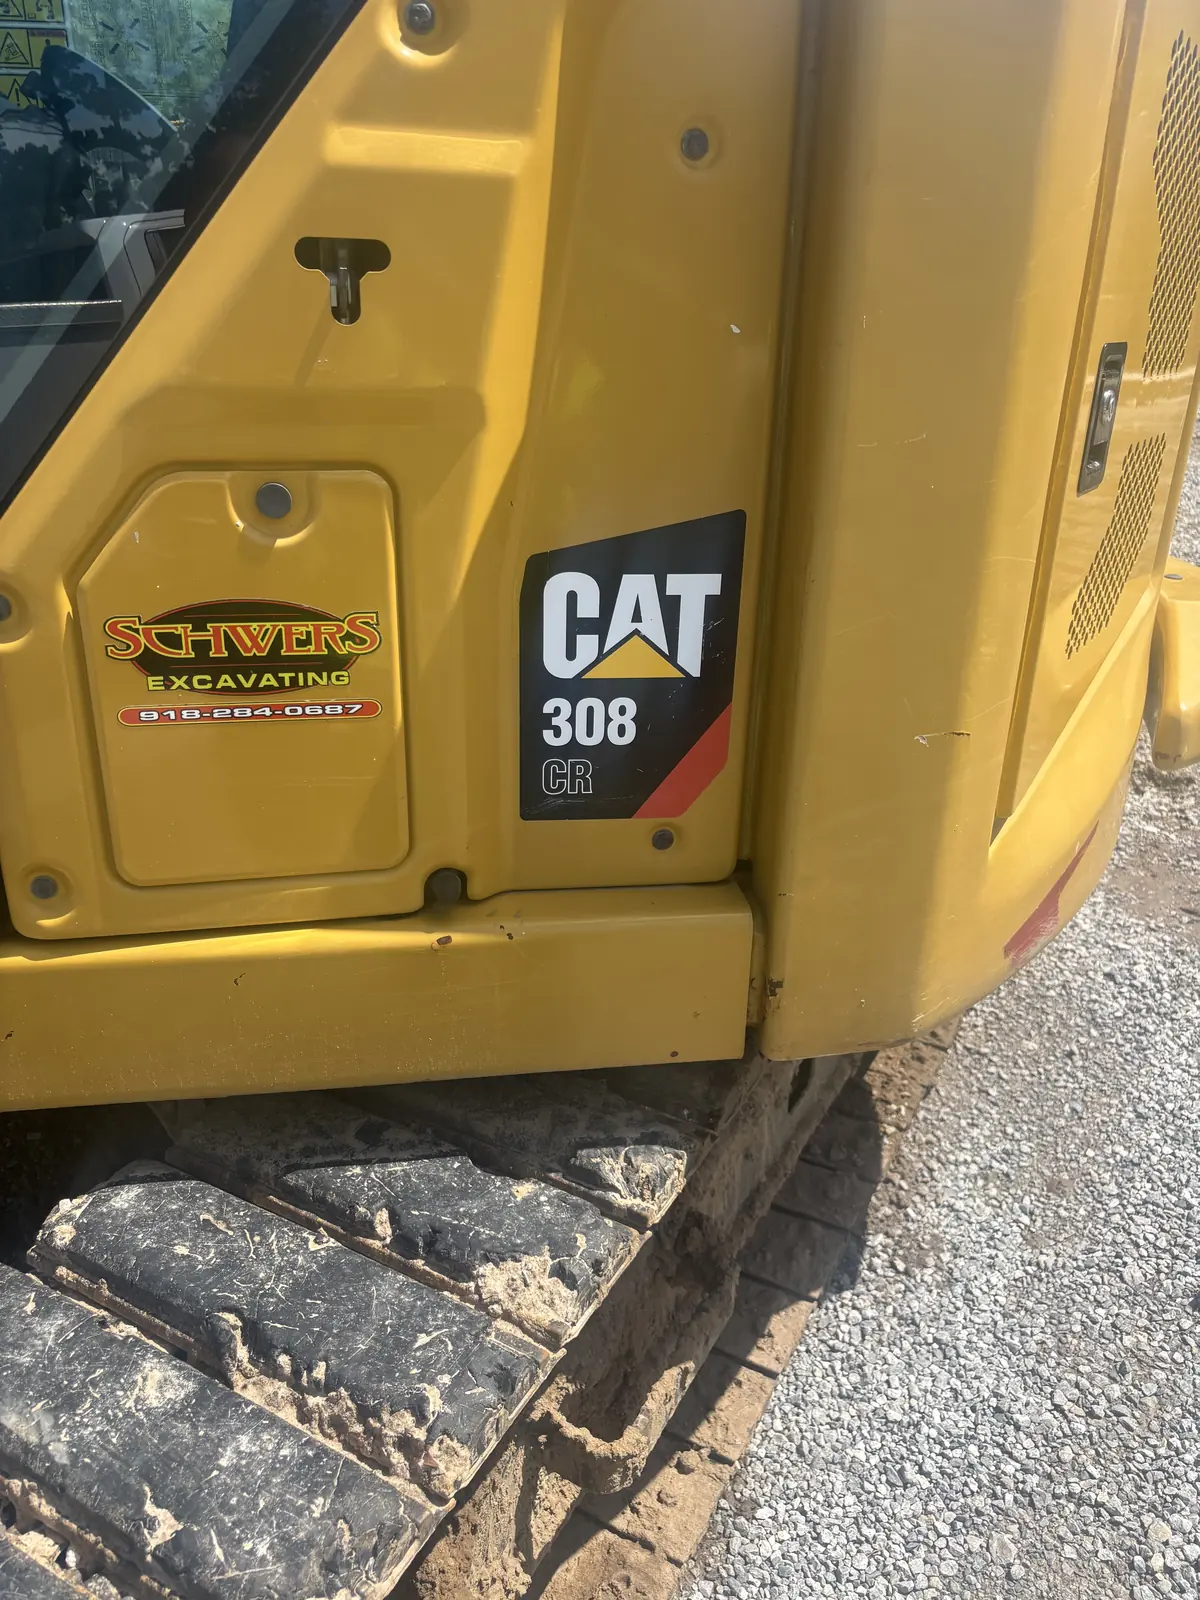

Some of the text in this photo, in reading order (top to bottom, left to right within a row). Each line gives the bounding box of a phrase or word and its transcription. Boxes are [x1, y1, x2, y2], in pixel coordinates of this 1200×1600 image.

[104, 612, 381, 659] SCHWERS
[543, 571, 722, 679] CAT
[147, 670, 350, 691] EXCAVATING
[139, 704, 363, 721] 918-284-0687
[542, 697, 637, 746] 308
[542, 758, 593, 794] CR
